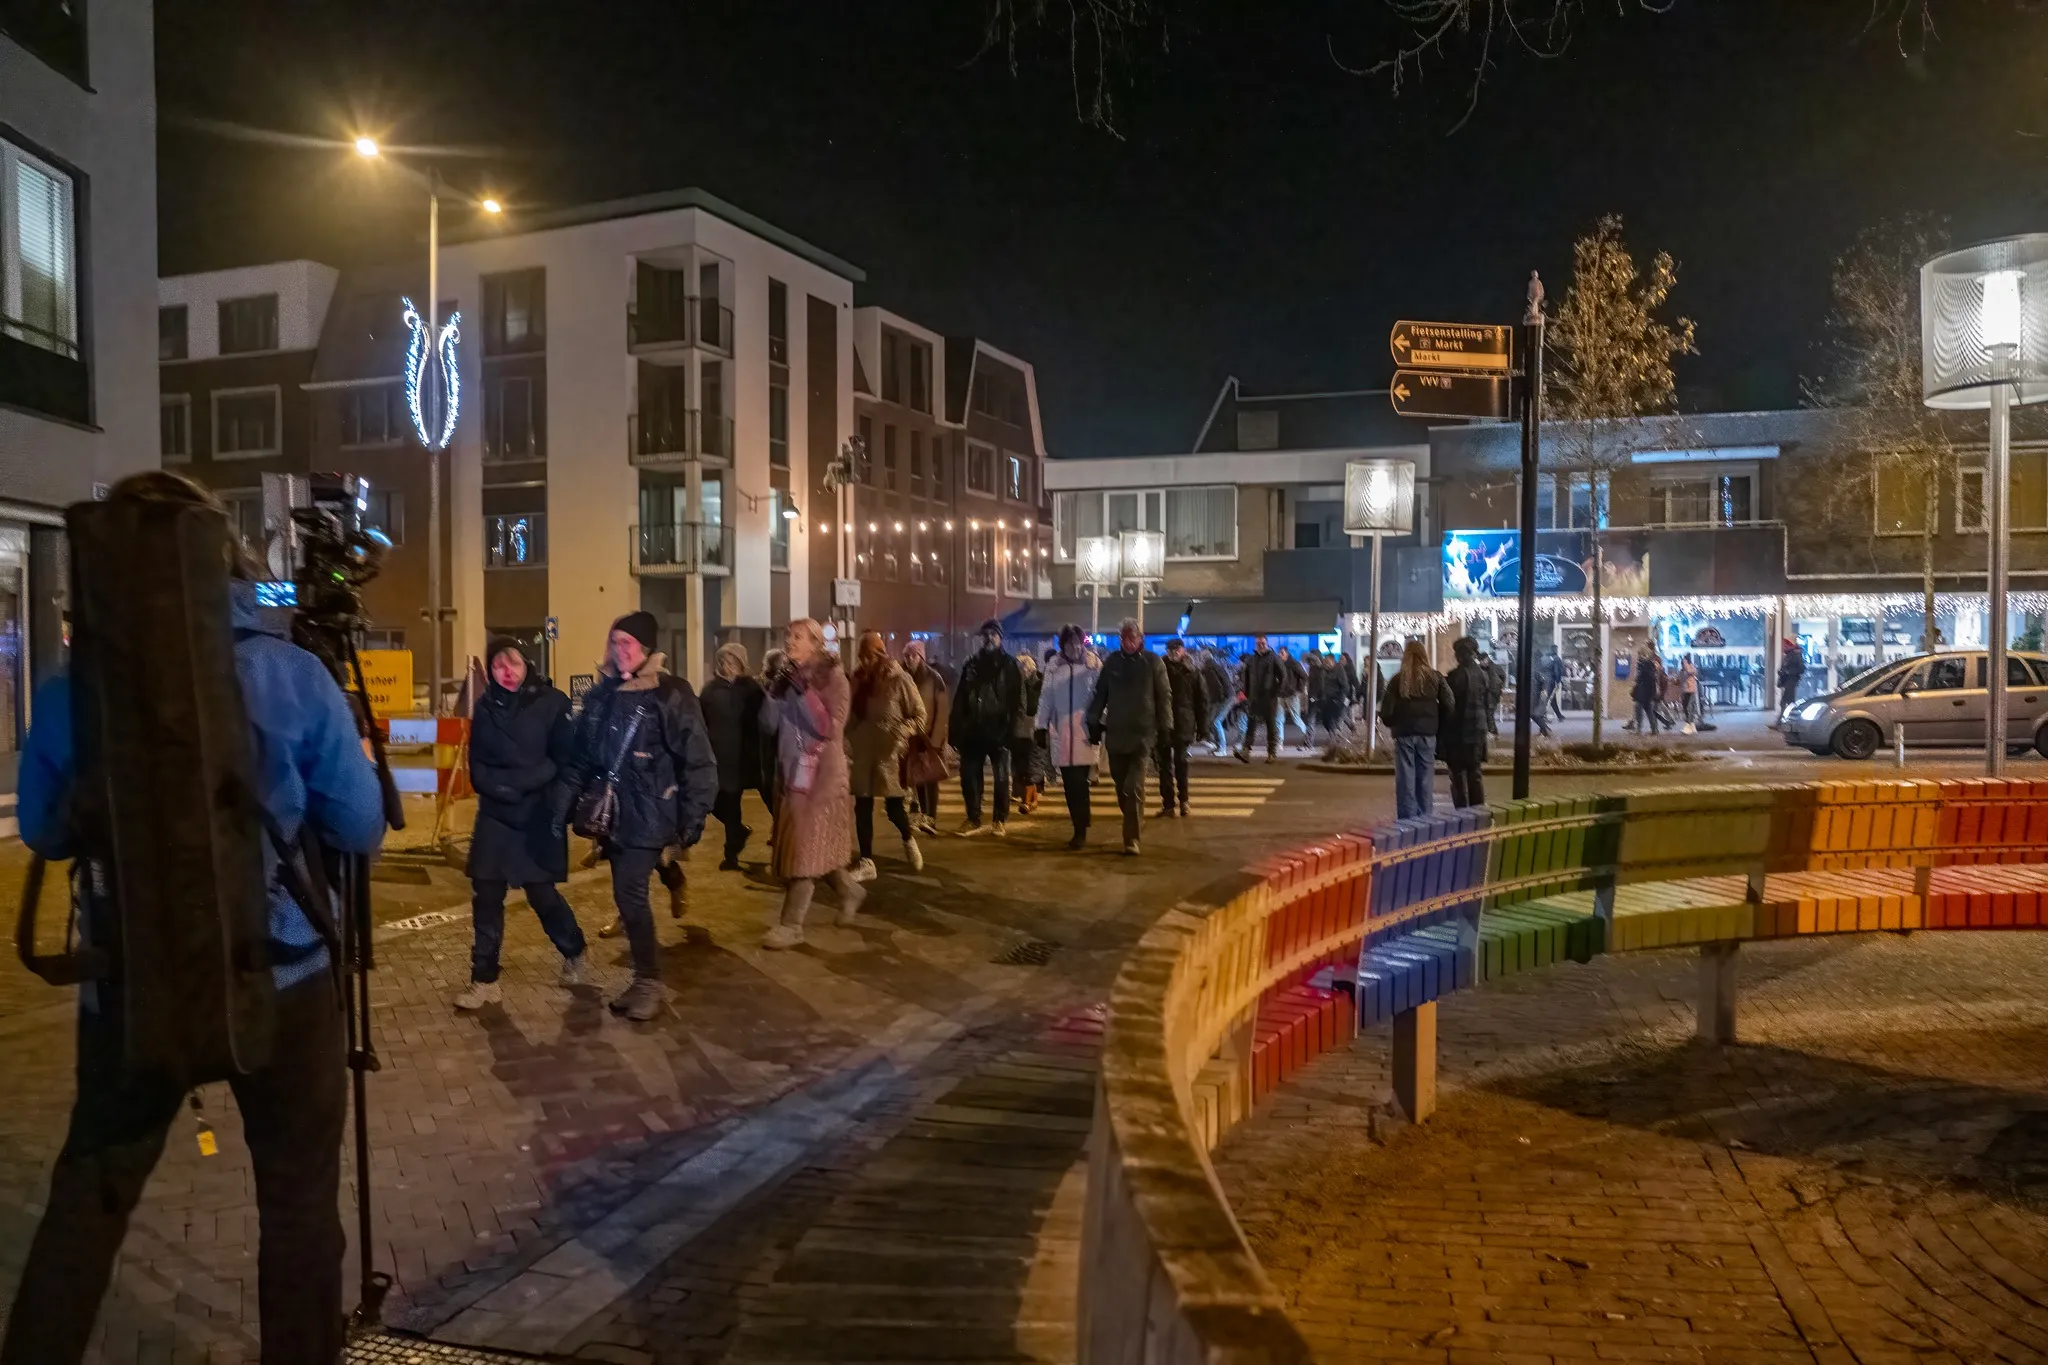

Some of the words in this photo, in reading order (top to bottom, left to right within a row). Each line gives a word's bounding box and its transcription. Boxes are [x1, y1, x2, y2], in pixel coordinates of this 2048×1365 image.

[1411, 325, 1482, 342] Fietsenstalling
[1435, 339, 1464, 350] Markt
[1414, 352, 1440, 361] Markt
[1420, 375, 1439, 387] VVV
